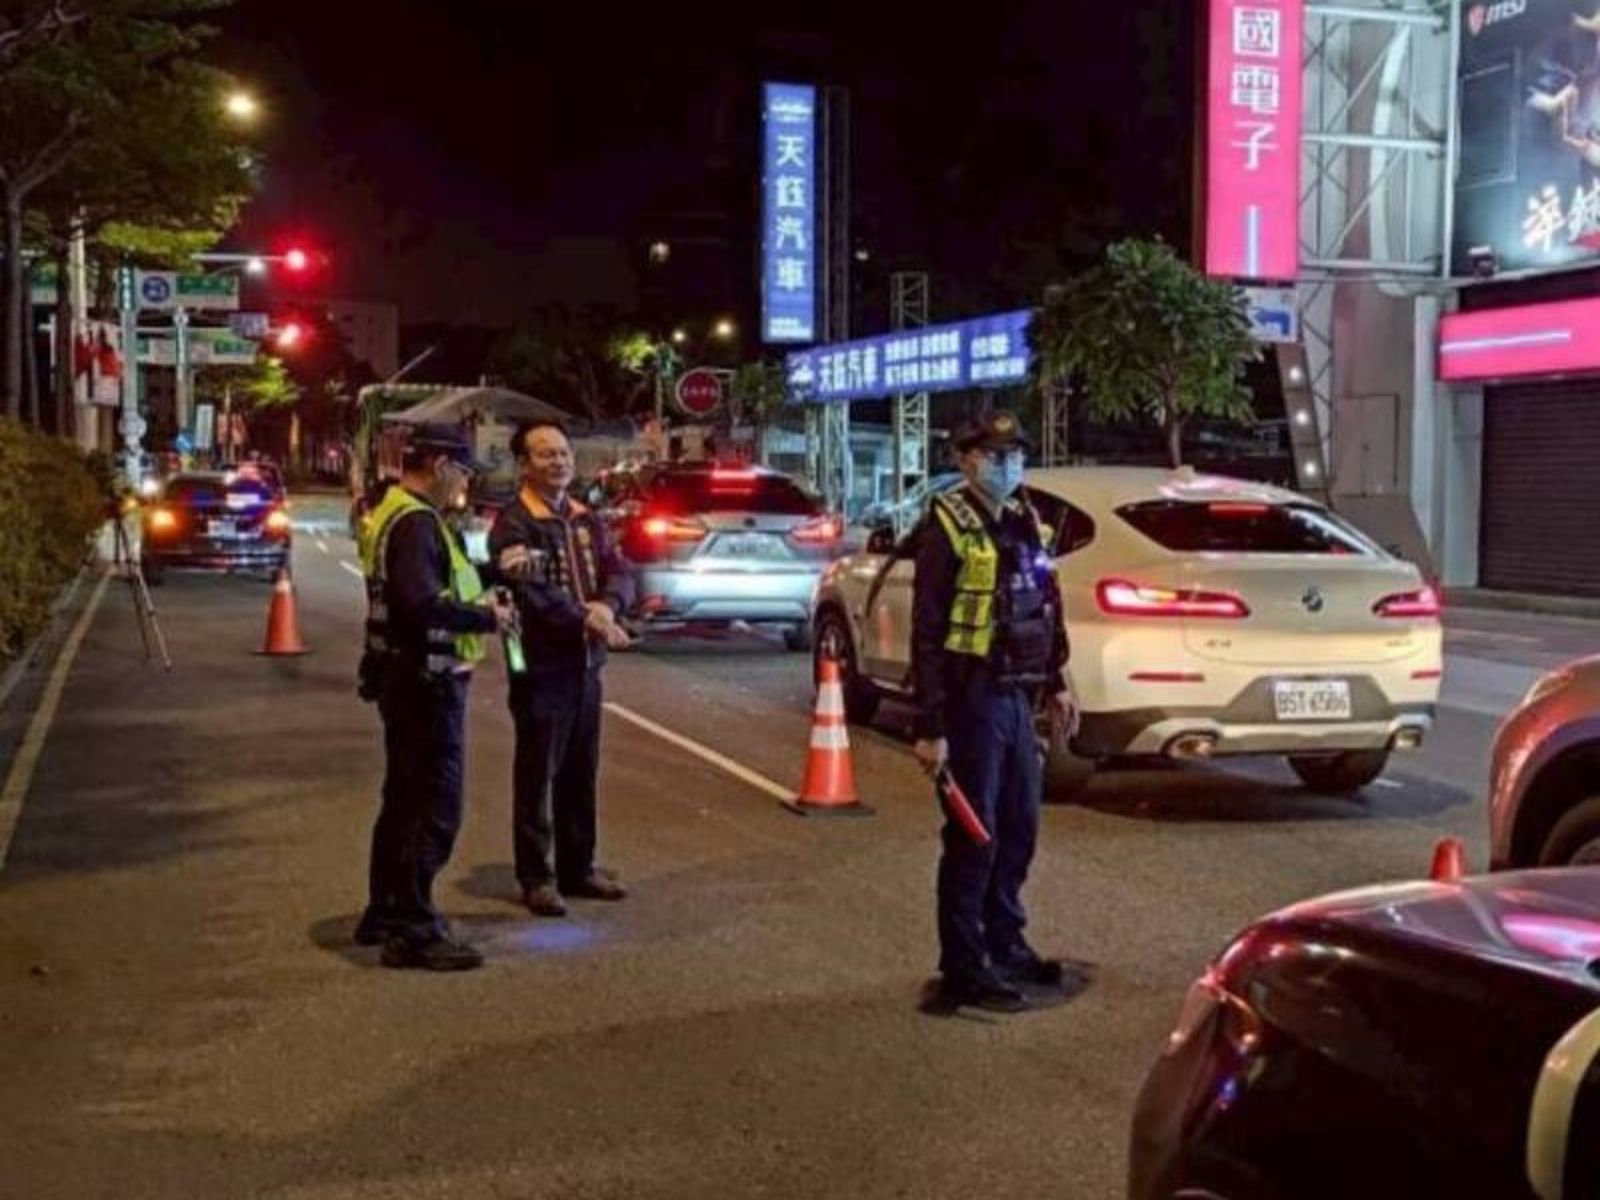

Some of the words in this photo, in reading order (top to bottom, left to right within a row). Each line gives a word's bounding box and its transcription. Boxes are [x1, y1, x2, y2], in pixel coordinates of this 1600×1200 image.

[1231, 6, 1280, 170] 國電子
[776, 135, 805, 292] 天鈺汽車
